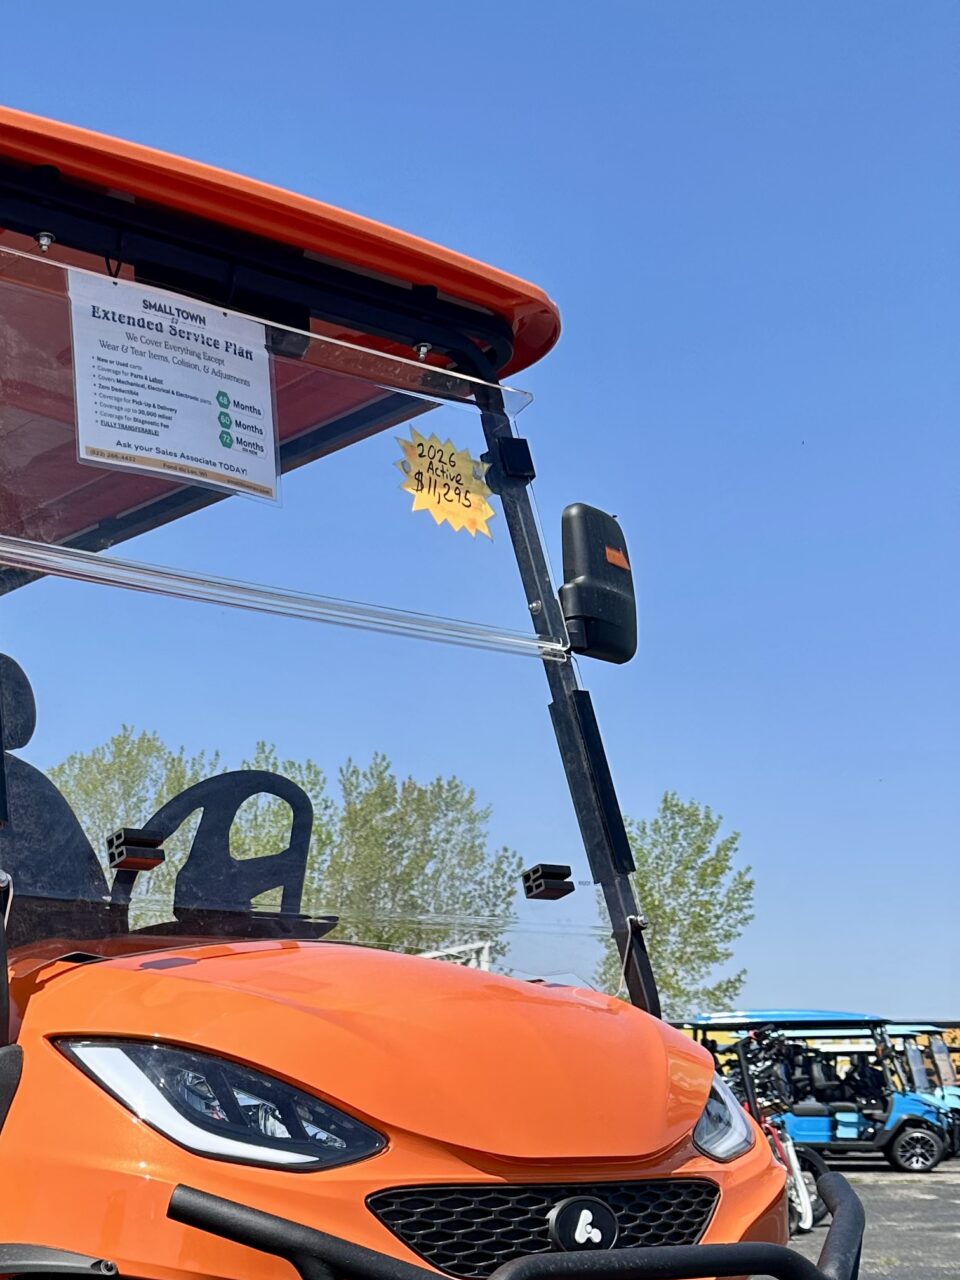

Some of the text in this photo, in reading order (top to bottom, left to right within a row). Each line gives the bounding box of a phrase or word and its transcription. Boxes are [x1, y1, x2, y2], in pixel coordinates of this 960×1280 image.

[91, 305, 254, 361] Extended Service Plan
[125, 331, 225, 366] We Cover Everything Except
[97, 355, 109, 364] New
[116, 360, 129, 368] Used
[99, 339, 119, 352] Wear
[121, 343, 129, 353] &
[130, 346, 146, 358] Tear
[148, 350, 170, 364] Items,
[203, 365, 210, 374] &
[211, 368, 251, 387] Adjustments
[97, 365, 121, 376] Coverage
[130, 372, 144, 380] Parts
[98, 383, 110, 391] Zero
[148, 384, 171, 394] Electrical
[99, 392, 122, 402] Coverage
[132, 398, 151, 408] Pick-Up
[157, 404, 177, 414] Delivery
[99, 401, 123, 412] Coverage
[233, 400, 262, 416] Months
[100, 410, 124, 421] Coverage
[133, 417, 159, 428] Diagnostic
[101, 420, 117, 430] FULLY
[235, 420, 263, 436] Months
[236, 436, 264, 453] Months
[116, 439, 132, 449] Ask
[134, 443, 153, 453] your
[155, 446, 178, 458] Sales
[180, 451, 217, 468] Associate
[417, 443, 457, 468] 2026
[427, 461, 463, 486] Active
[412, 469, 472, 509] $11,295
